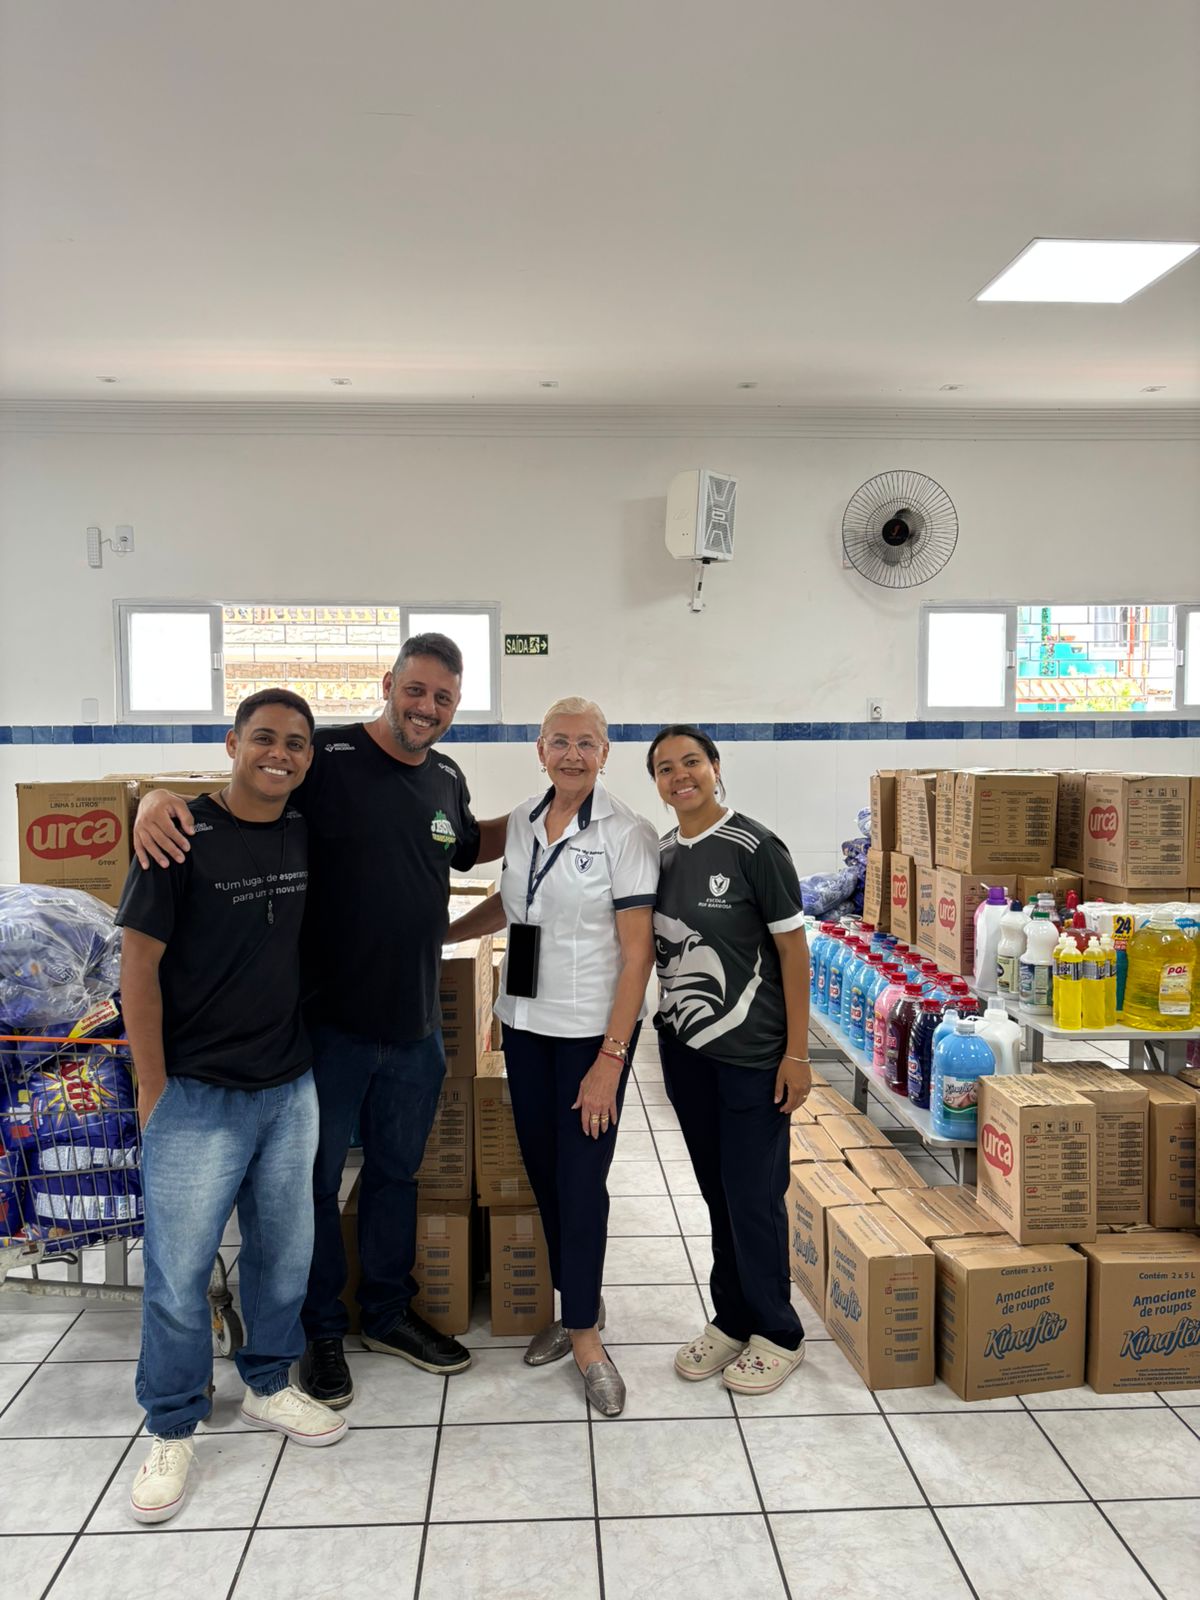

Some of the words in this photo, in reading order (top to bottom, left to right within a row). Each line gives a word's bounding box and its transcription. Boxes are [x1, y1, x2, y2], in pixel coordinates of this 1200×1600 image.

[506, 635, 528, 653] SAÍDA
[1090, 812, 1117, 832] urca
[32, 817, 116, 851] urca
[266, 873, 278, 883] de
[232, 891, 254, 904] para
[276, 884, 295, 894] nova
[939, 903, 955, 922] urca
[1115, 915, 1132, 935] 24
[983, 1129, 1012, 1169] urca
[1001, 1267, 1028, 1276] Contém
[1139, 1272, 1168, 1280] Contém
[995, 1280, 1055, 1305] Amaciante
[1132, 1288, 1197, 1308] Amaciante
[1002, 1302, 1014, 1315] de
[1016, 1295, 1051, 1312] roupas
[1140, 1305, 1153, 1317] de
[1155, 1301, 1192, 1315] roupas
